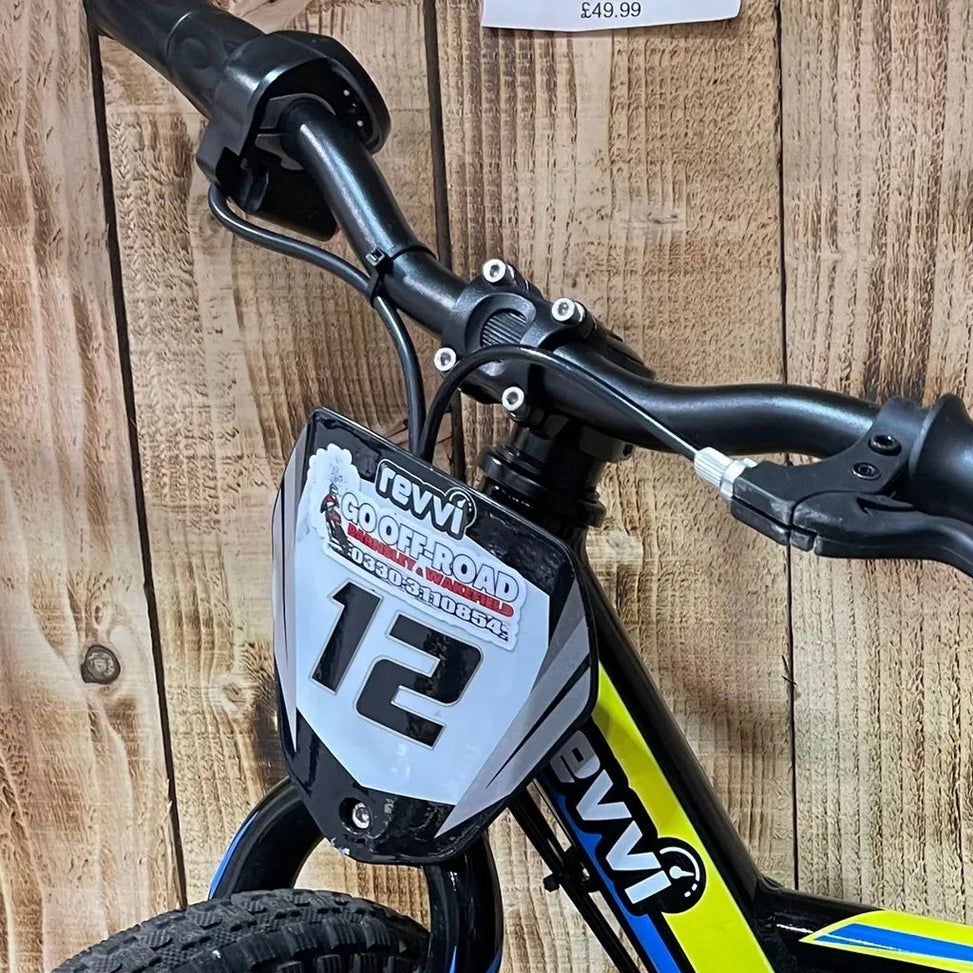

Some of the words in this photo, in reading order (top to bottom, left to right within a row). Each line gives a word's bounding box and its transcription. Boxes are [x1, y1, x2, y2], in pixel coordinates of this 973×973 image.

[580, 2, 641, 18] £49.99
[379, 463, 467, 536] revvi
[341, 492, 377, 534] GO
[378, 515, 519, 603] OFF-ROAD
[424, 566, 514, 617] WAKEFIELD
[310, 580, 484, 749] 12
[550, 730, 682, 905] evvi
